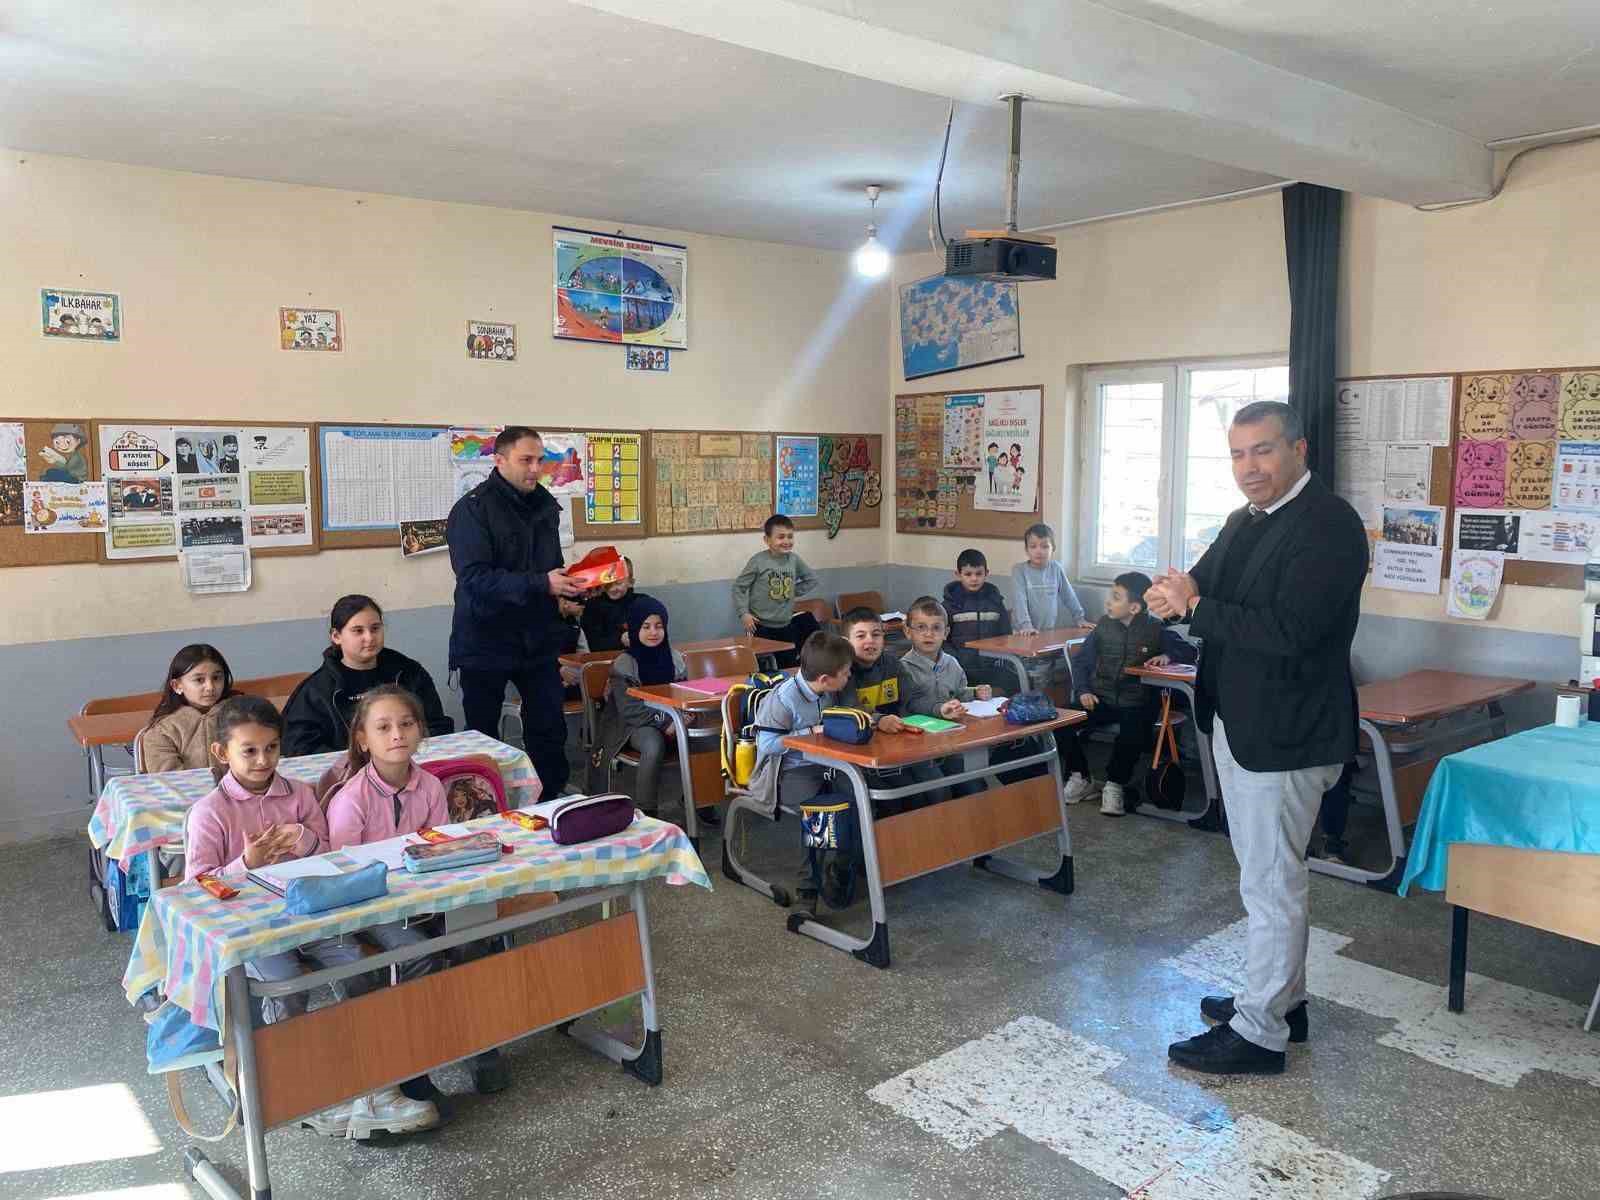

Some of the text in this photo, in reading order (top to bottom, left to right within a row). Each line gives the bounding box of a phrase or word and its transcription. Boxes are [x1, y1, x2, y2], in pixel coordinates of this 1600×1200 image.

[61, 296, 102, 311] İLKBAHAR
[304, 313, 318, 324] YAZ
[613, 444, 620, 458] 2
[589, 461, 595, 473] 3
[588, 476, 620, 489] 5 6
[863, 470, 882, 508] 8
[588, 492, 595, 505] 7
[589, 507, 595, 520] 9
[824, 499, 843, 539] 9
